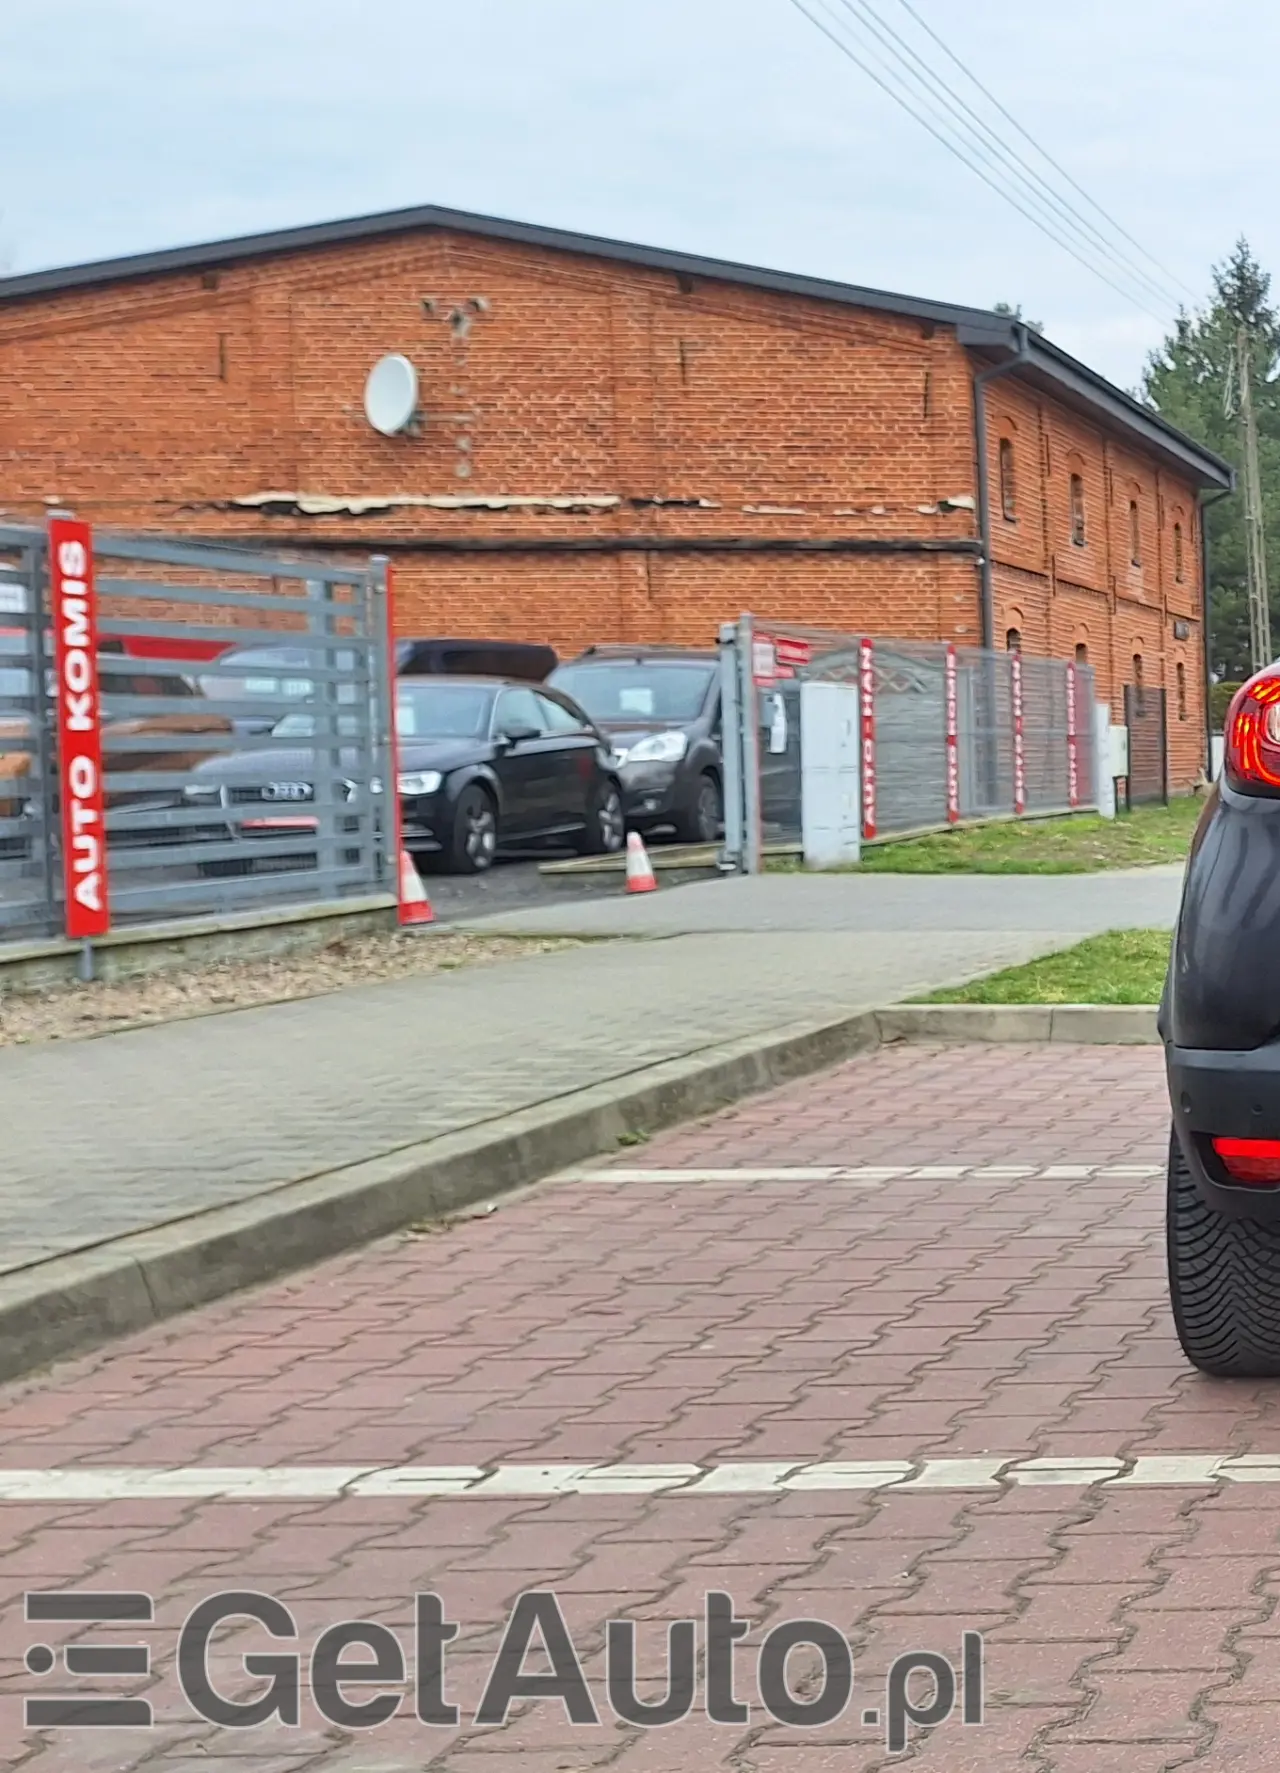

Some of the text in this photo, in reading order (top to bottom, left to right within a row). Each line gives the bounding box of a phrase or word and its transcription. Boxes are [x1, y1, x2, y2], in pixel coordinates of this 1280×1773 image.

[860, 647, 873, 716] HAN
[57, 539, 101, 912] AUTO KOMIS
[863, 739, 875, 825] AUTO
